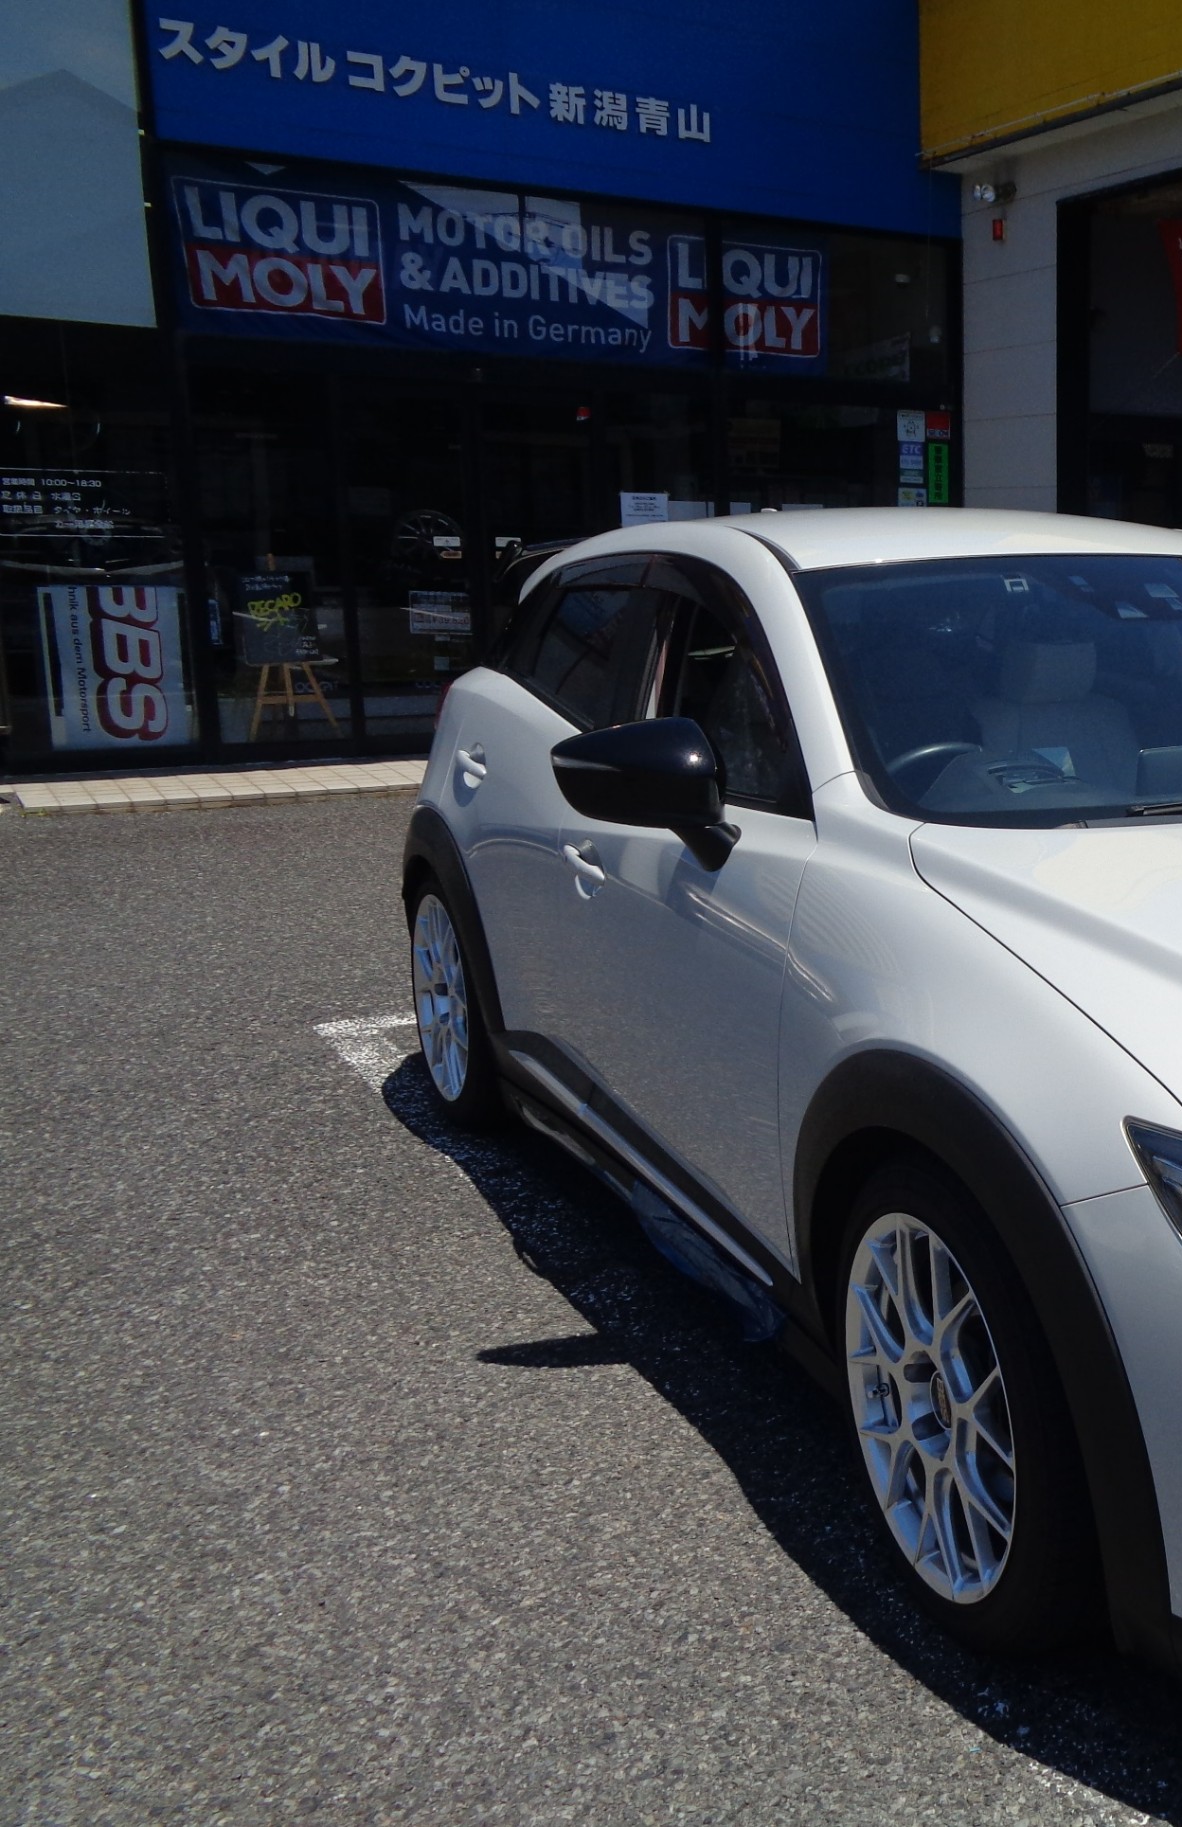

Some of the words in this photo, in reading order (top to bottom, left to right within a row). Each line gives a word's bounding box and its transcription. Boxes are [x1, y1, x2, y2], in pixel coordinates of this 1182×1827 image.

[184, 184, 372, 257] LIQUI
[397, 202, 552, 257] MOTOR
[562, 222, 653, 266] OILS
[195, 250, 378, 316] MOLY
[399, 252, 433, 291] &
[439, 257, 655, 309] ADDITIVES
[677, 242, 813, 299] LQUI
[403, 303, 484, 336] Made
[494, 312, 518, 339] in
[528, 314, 652, 353] Germany
[70, 614, 80, 636] aus
[71, 638, 84, 665] dem
[76, 667, 92, 733] Motorsport
